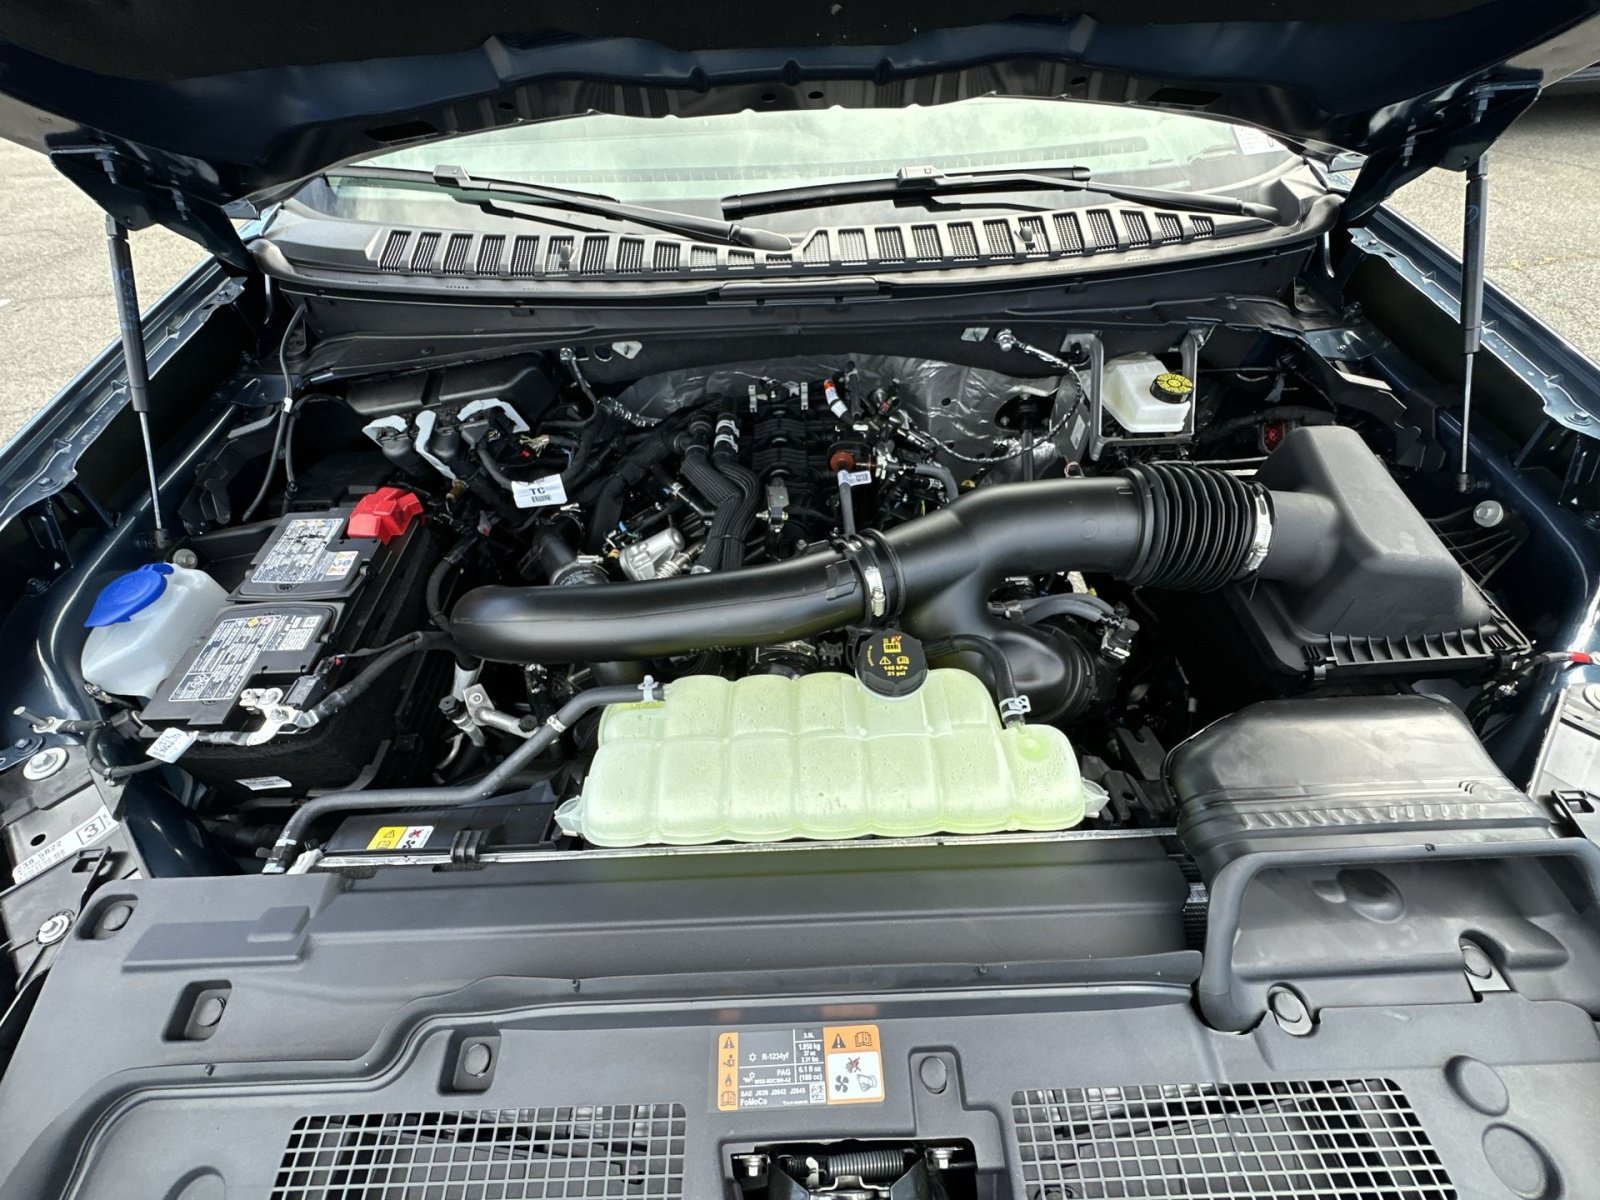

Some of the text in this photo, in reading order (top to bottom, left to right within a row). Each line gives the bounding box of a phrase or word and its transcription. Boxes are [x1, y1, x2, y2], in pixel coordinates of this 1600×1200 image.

[529, 487, 546, 495] TC
[84, 823, 99, 838] 3
[813, 1042, 821, 1051] kg
[762, 1052, 789, 1061] R-1234yf
[740, 1098, 768, 1106] FoMoCo
